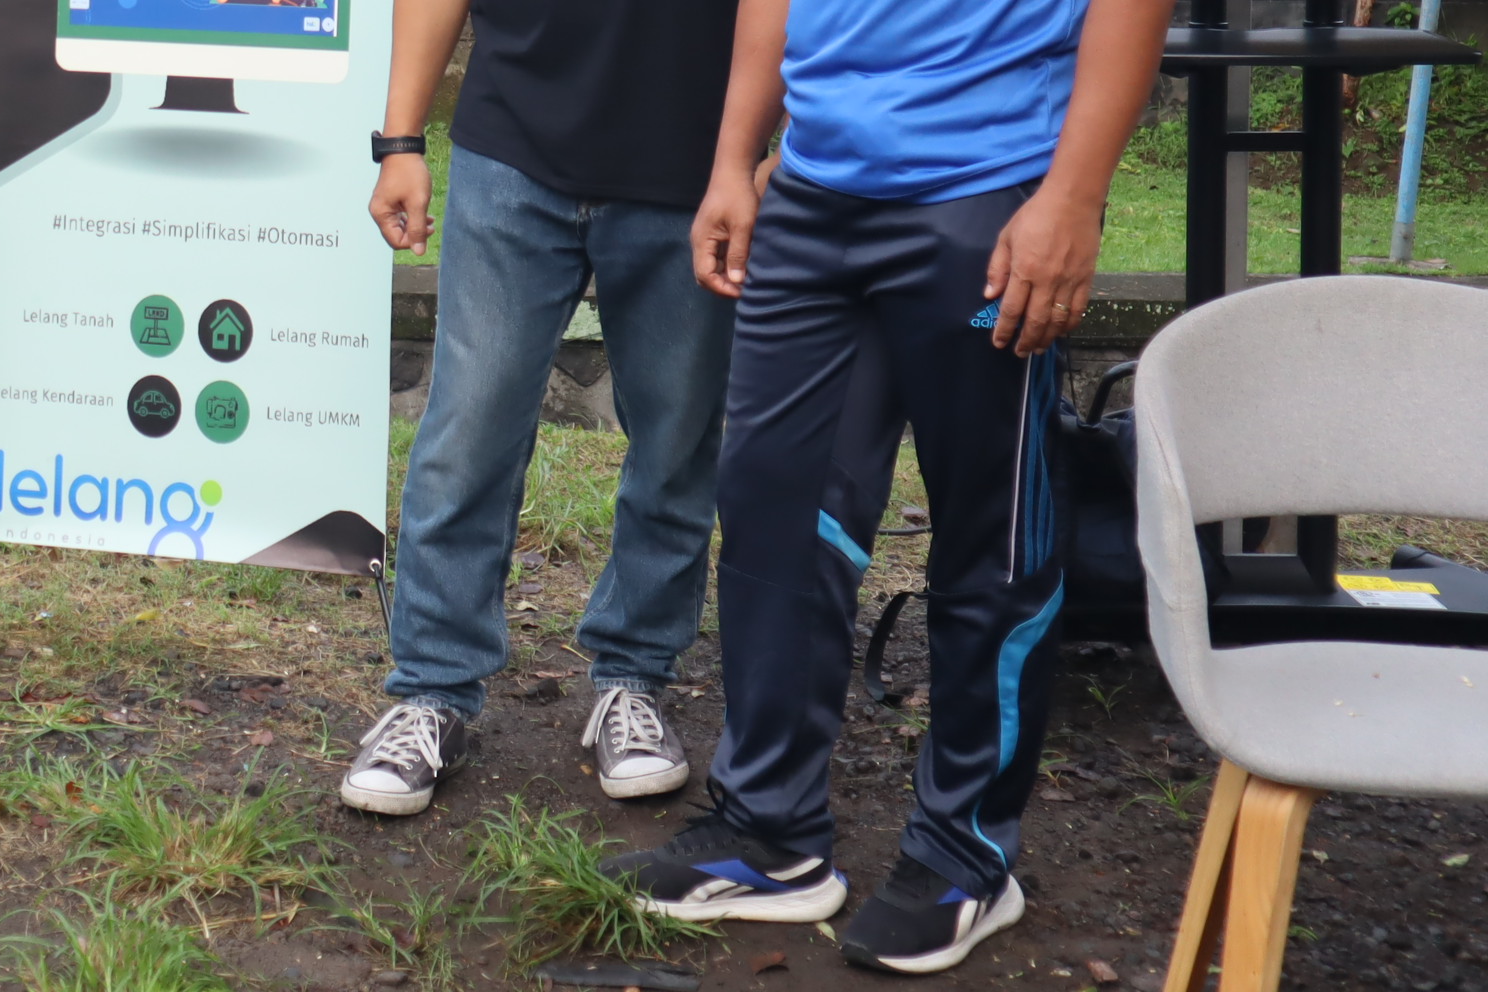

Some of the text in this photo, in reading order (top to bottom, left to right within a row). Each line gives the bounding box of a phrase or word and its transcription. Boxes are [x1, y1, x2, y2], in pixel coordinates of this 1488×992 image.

[53, 214, 339, 248] #Integrasi #Simplifikasi #Otomasi
[23, 309, 113, 328] Lelang Tanah
[970, 317, 999, 328] adi
[270, 328, 369, 349] Lelang Rumah
[42, 388, 113, 407] Kendaraan
[267, 407, 360, 427] Lelang UMKM
